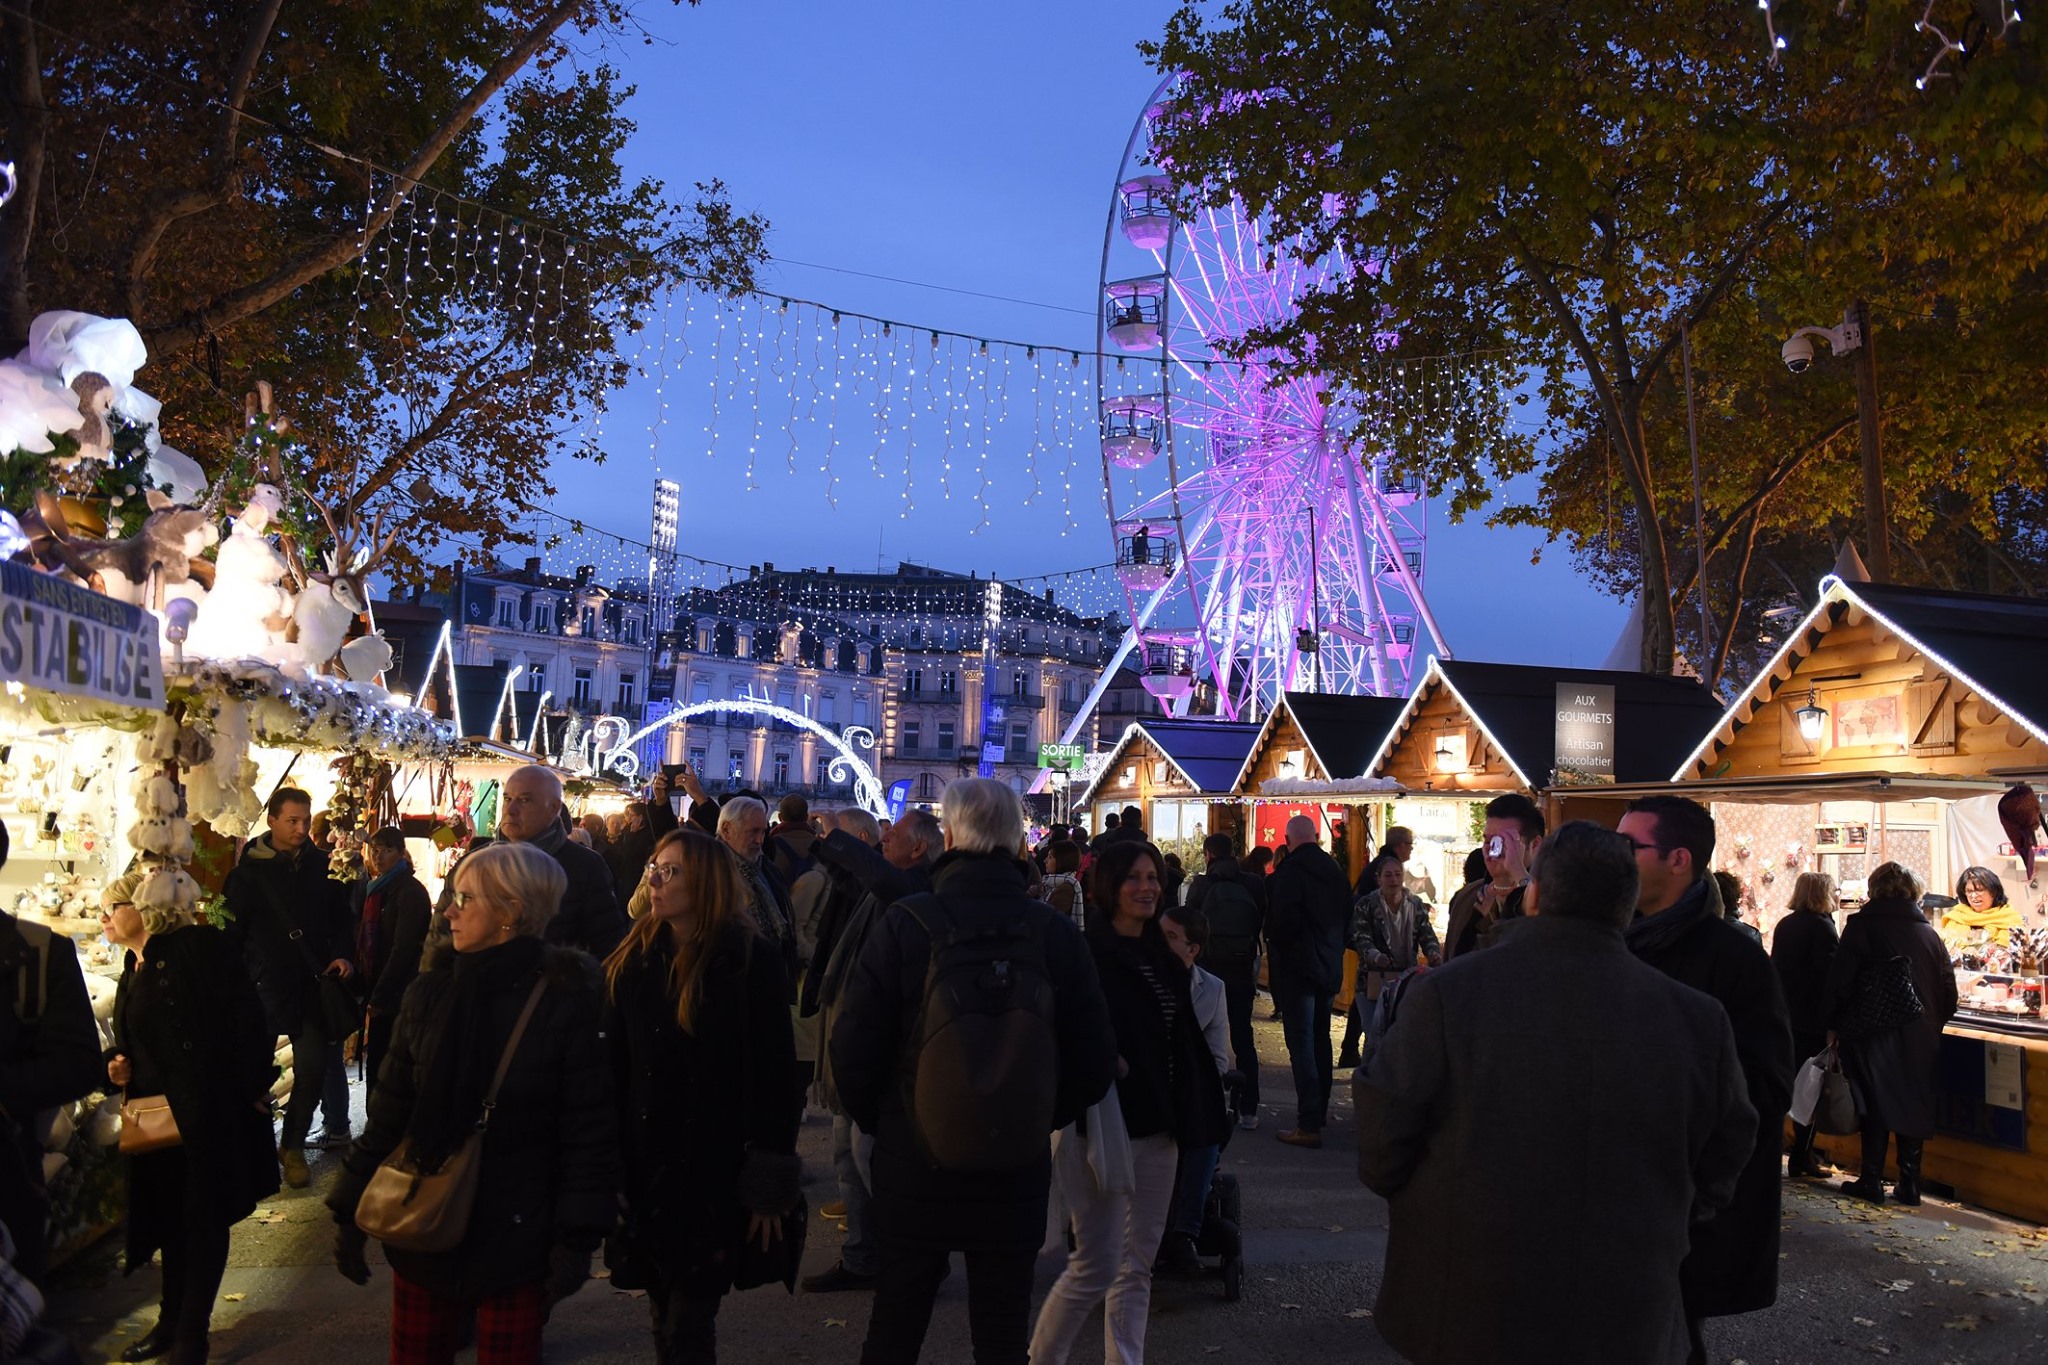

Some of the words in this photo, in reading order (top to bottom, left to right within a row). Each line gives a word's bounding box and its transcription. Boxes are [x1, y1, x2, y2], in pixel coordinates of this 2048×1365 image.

[32, 576, 69, 611] SANS
[1574, 695, 1596, 706] AUX
[1557, 711, 1612, 724] GOURMETS
[1565, 737, 1604, 750] Artisan
[1041, 744, 1081, 757] SORTIE
[1556, 753, 1612, 767] chocolatier
